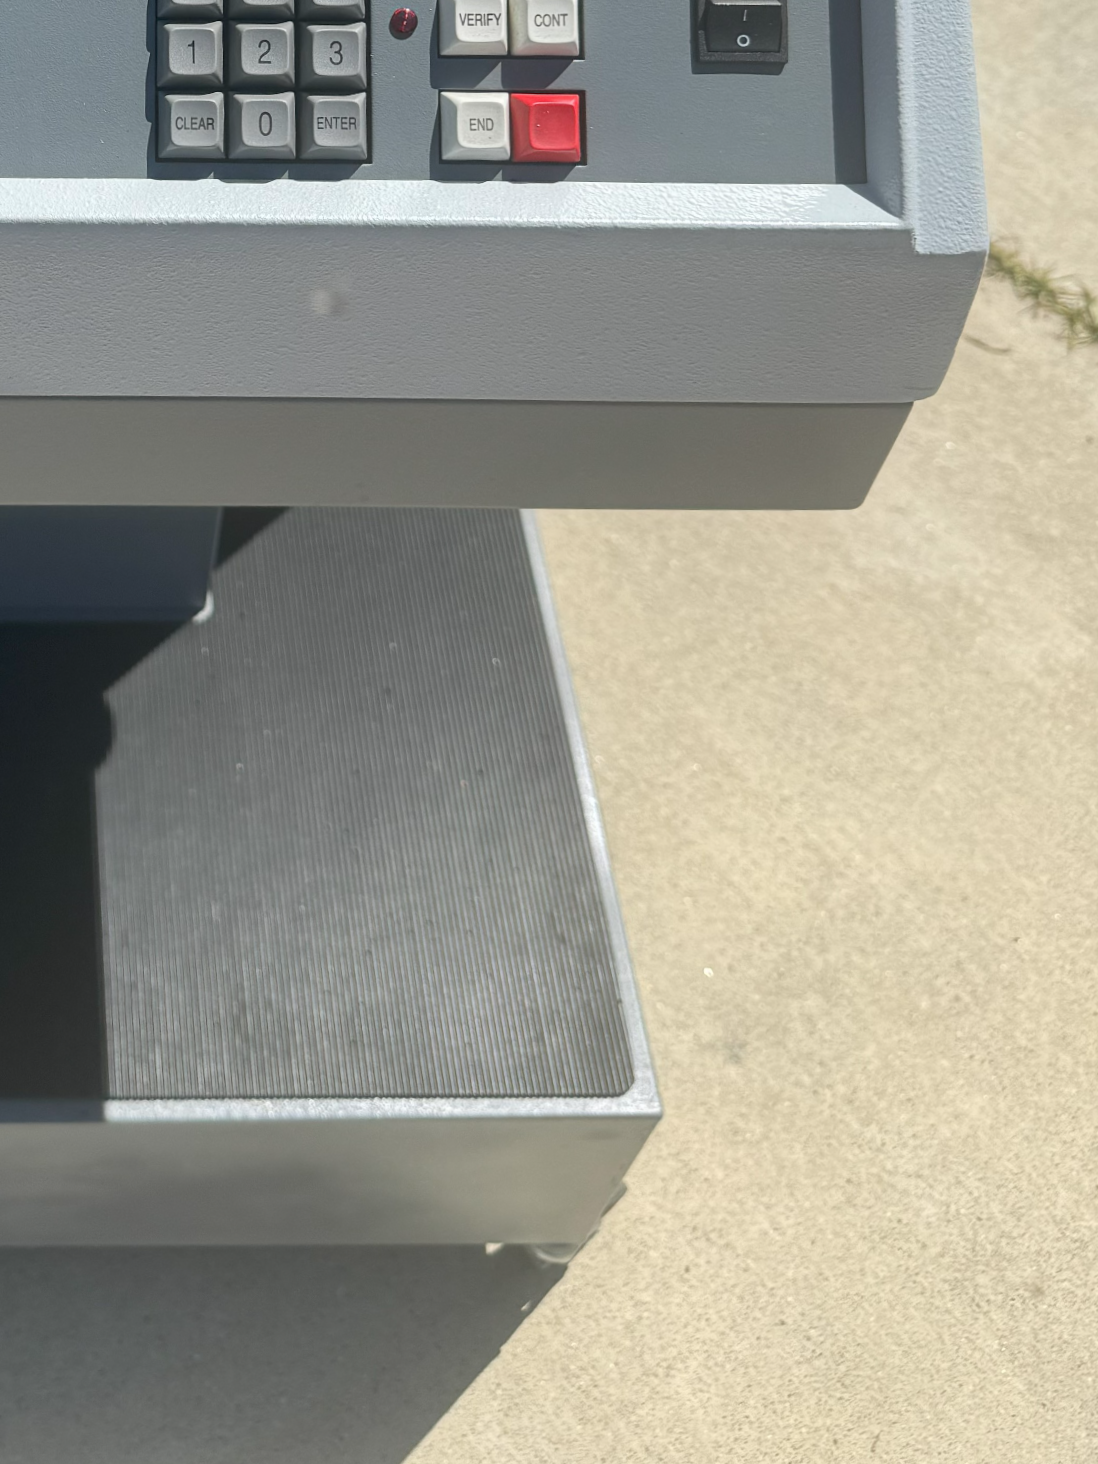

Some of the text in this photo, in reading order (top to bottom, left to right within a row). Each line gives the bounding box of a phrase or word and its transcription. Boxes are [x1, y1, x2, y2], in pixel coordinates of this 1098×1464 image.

[459, 13, 502, 27] VERIFY
[533, 13, 569, 28] CONT
[187, 39, 197, 65] 1
[257, 39, 272, 65] 2
[329, 40, 344, 66] 3
[175, 116, 215, 131] CLEAR
[258, 111, 273, 137] 0
[316, 116, 357, 131] ENTER
[469, 117, 495, 132] END
